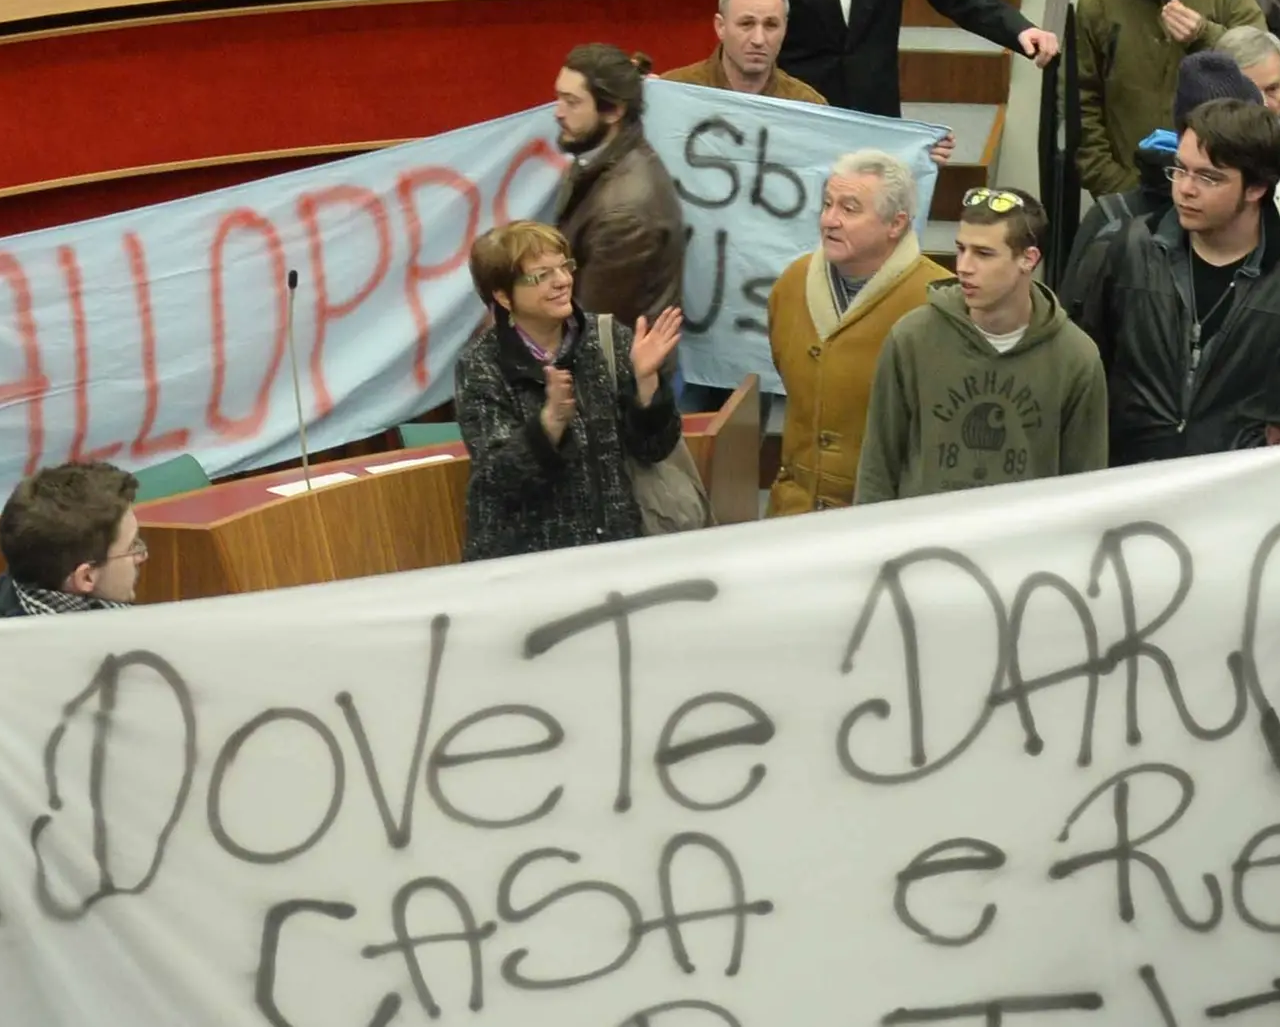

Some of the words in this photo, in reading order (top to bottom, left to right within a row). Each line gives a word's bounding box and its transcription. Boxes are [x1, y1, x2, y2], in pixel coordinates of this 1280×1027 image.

[932, 372, 1043, 432] CARHARTT
[937, 442, 960, 470] 18
[1003, 447, 1028, 476] 89
[255, 832, 773, 1027] CASA
